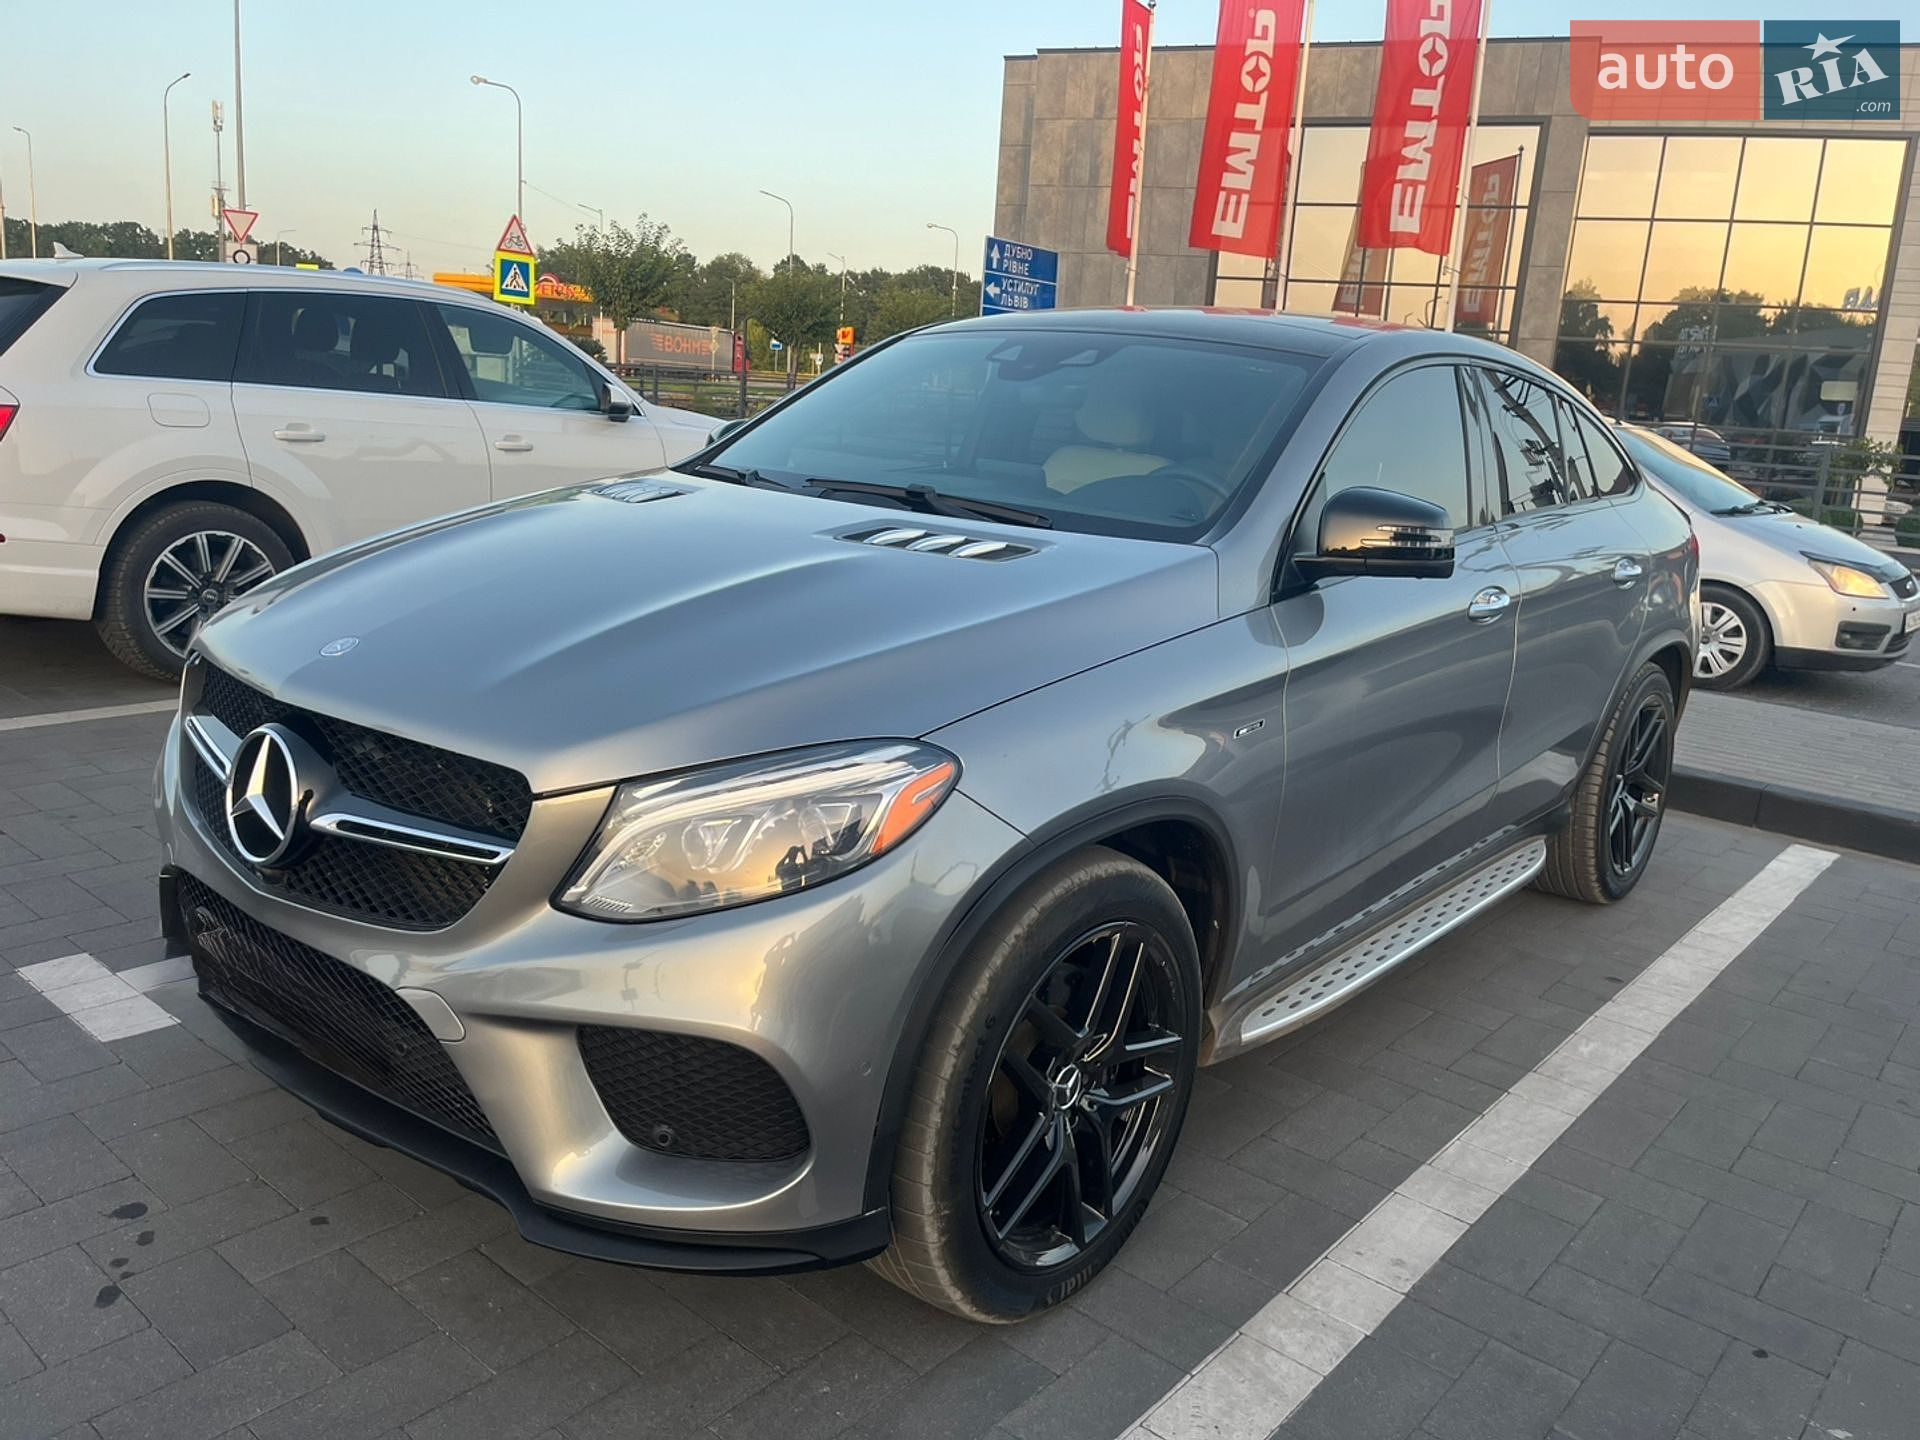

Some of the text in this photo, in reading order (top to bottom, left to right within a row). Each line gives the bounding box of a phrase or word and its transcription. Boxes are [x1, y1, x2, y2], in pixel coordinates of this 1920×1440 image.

[1004, 243, 1033, 260] ДУБНО
[1002, 259, 1030, 276] РІВНЕ
[1000, 293, 1029, 309] ЛЬВІВ
